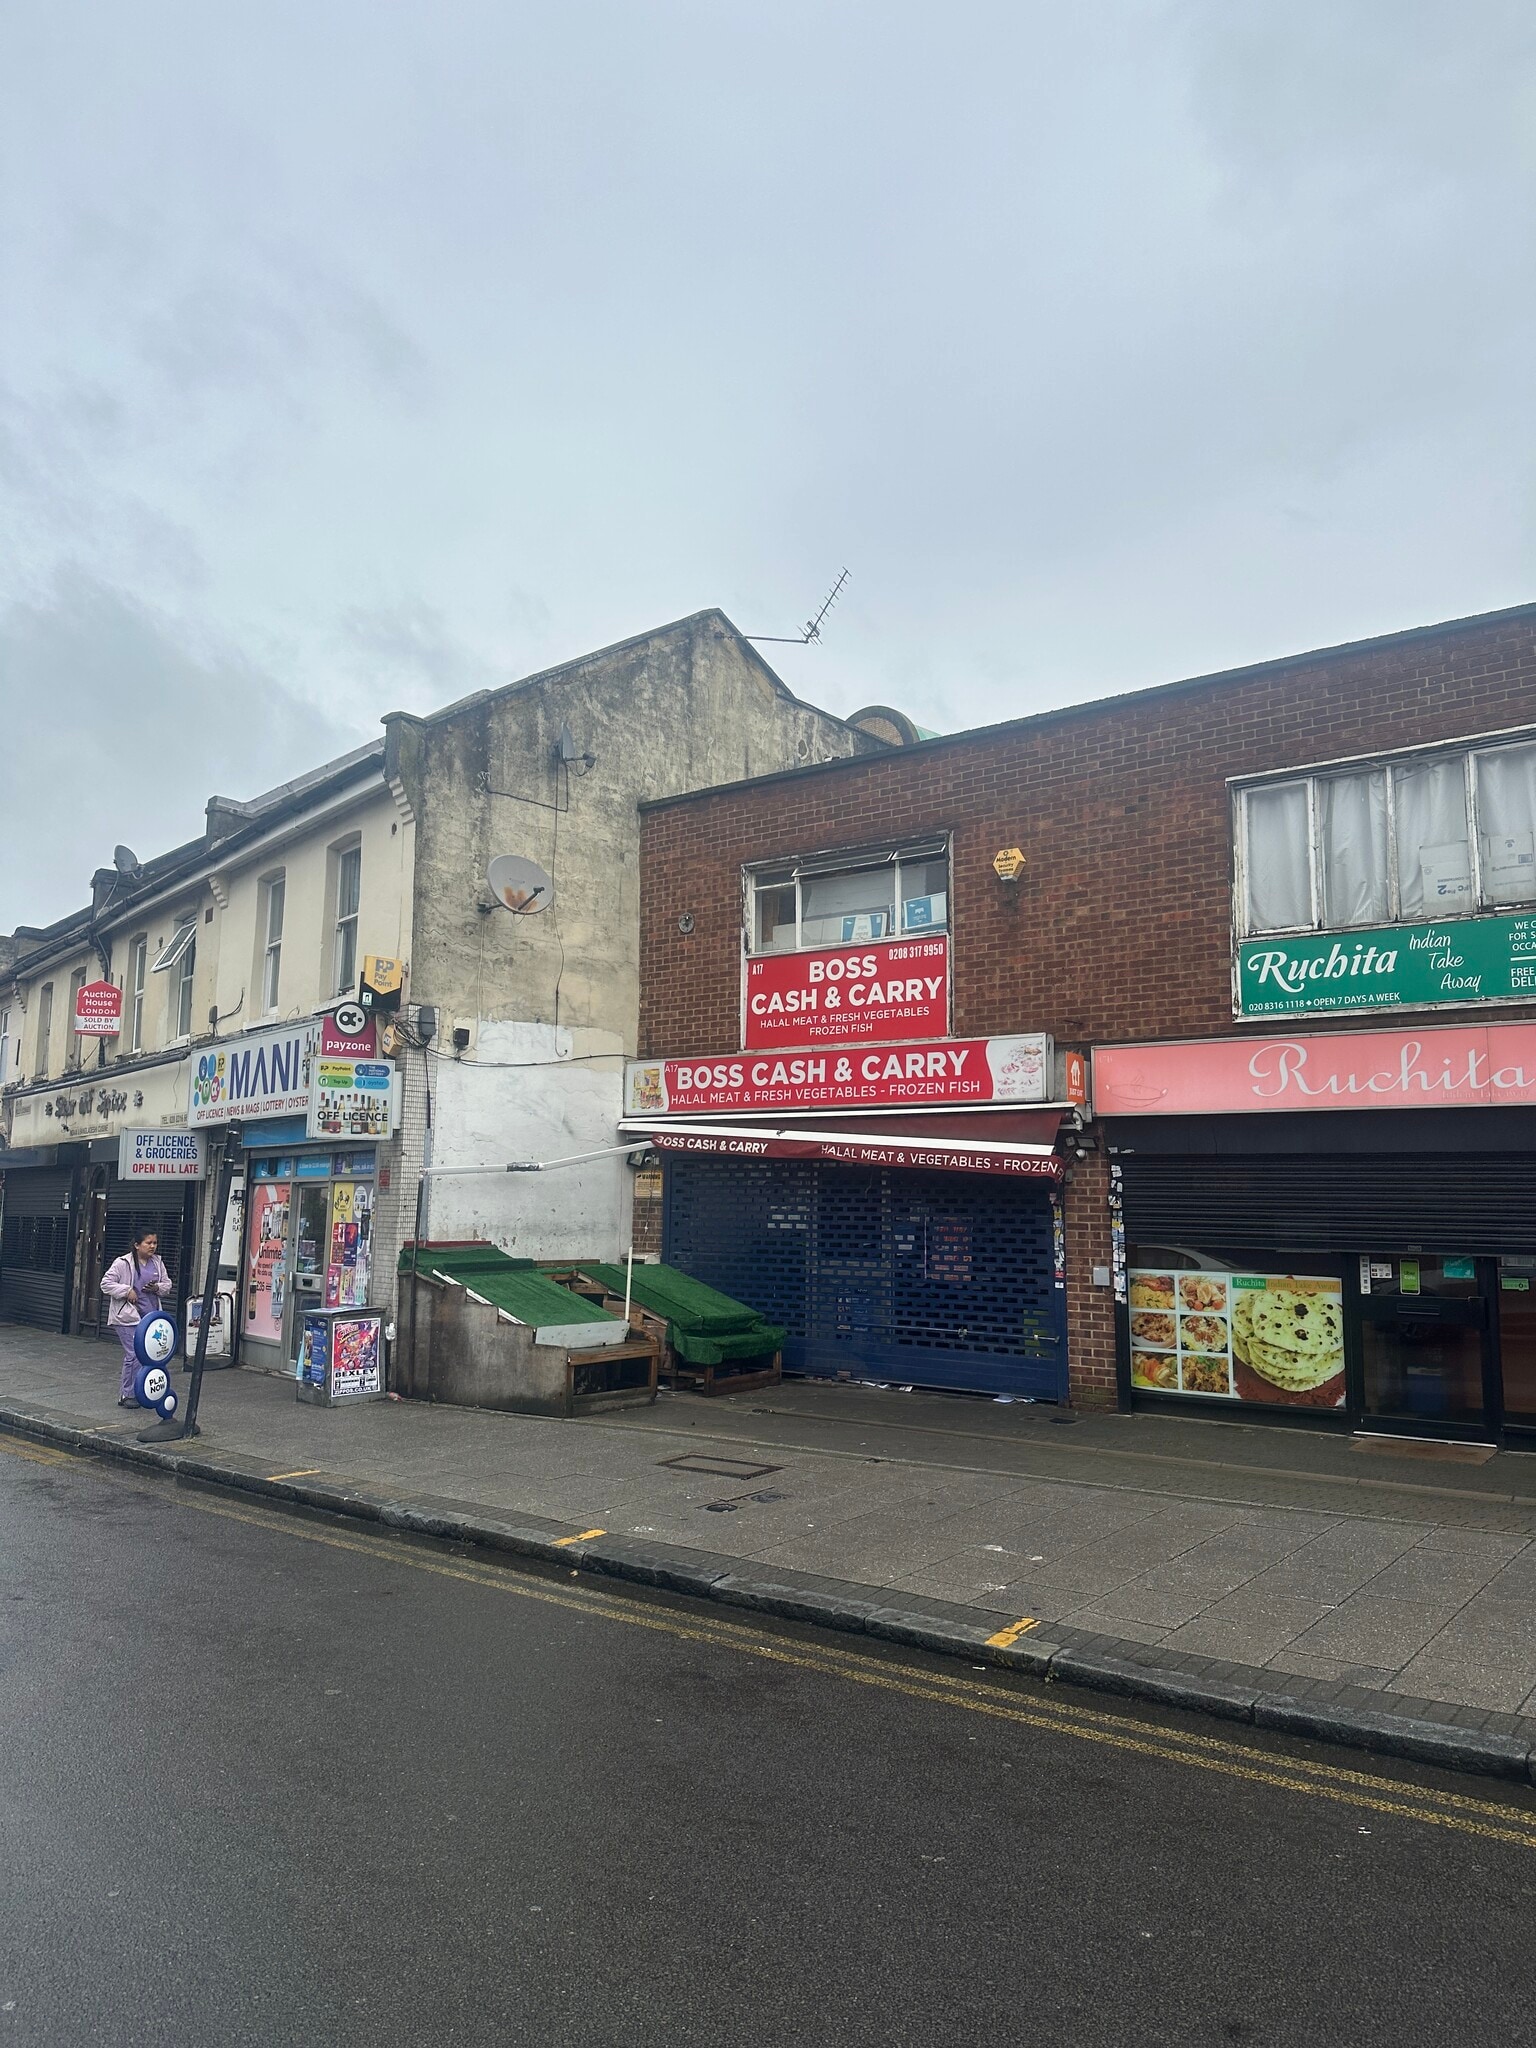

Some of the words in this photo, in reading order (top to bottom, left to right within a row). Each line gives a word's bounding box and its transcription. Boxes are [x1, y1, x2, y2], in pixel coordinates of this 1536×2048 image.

[1514, 921, 1529, 930] WE
[1409, 929, 1451, 950] Indian
[1508, 932, 1527, 941] FOR
[888, 947, 908, 961] 0208
[908, 945, 922, 959] 317
[923, 943, 944, 957] 9950
[1428, 947, 1465, 970] Take
[752, 963, 764, 975] A17
[809, 955, 878, 983] BOSS
[1247, 943, 1398, 993] Ruchita
[1510, 966, 1535, 977] FREE
[373, 979, 393, 988] Point
[1440, 973, 1482, 993] Away
[83, 990, 118, 999] Auction
[751, 988, 818, 1015] CASH
[824, 986, 841, 1008] &
[848, 976, 944, 1007] CARRY
[85, 998, 113, 1007] House
[1248, 1003, 1264, 1011] 020
[1264, 1001, 1284, 1010] 8316
[1285, 999, 1305, 1009] 1118
[1313, 998, 1336, 1007] OPEN
[1338, 997, 1343, 1005] 7
[1344, 994, 1367, 1004] DAYS
[1368, 994, 1375, 1002] A
[1376, 992, 1400, 1001] WEEK
[760, 1017, 791, 1029] HALAL
[793, 1015, 817, 1026] MEAT
[820, 1015, 827, 1024] &
[829, 1012, 861, 1023] FRESH
[863, 1006, 930, 1020] VEGETABLES
[809, 1025, 849, 1036] FROZEN
[851, 1023, 873, 1034] FISH
[326, 1040, 371, 1052] payzone
[664, 1064, 678, 1073] A17
[677, 1063, 744, 1090] BOSS
[751, 1058, 826, 1087] CASH
[834, 1057, 853, 1081] &
[861, 1050, 970, 1080] CARRY
[1247, 1041, 1536, 1098] Ruchita
[671, 1094, 707, 1105] HALAL
[709, 1092, 741, 1103] MEAT
[743, 1091, 751, 1102] &
[754, 1089, 792, 1102] FRESH
[795, 1085, 877, 1100] VEGETABLES
[889, 1081, 942, 1096] FROZEN
[949, 1080, 980, 1093] FISH
[197, 1111, 206, 1120] OFF
[205, 1108, 224, 1119] LICENCE
[226, 1106, 240, 1117] NEWS
[240, 1105, 245, 1115] &
[244, 1102, 260, 1114] MAGS
[262, 1099, 285, 1112] LOTTERY
[288, 1095, 309, 1109] OYSTER
[317, 1111, 340, 1120] OFF
[343, 1111, 388, 1122] LICENCE
[136, 1135, 154, 1146] OFF
[156, 1135, 196, 1147] LICENCE
[686, 1138, 718, 1151] CASH
[719, 1141, 727, 1152] &
[728, 1141, 768, 1154] CARRY
[136, 1148, 143, 1159] &
[145, 1147, 198, 1160] GROCERIES
[821, 1144, 858, 1159] HALAL
[861, 1149, 895, 1162] MEAT
[896, 1152, 905, 1163] &
[910, 1152, 991, 1169] VEGETABLES
[1003, 1158, 1058, 1174] FROZEN
[132, 1163, 156, 1173] OPEN
[158, 1164, 176, 1173] TILL
[178, 1164, 199, 1174] LATE
[1236, 1278, 1265, 1287] Ruchita
[335, 1368, 376, 1378] BEXLEY
[149, 1375, 165, 1386] PLAY
[150, 1383, 166, 1394] NOW
